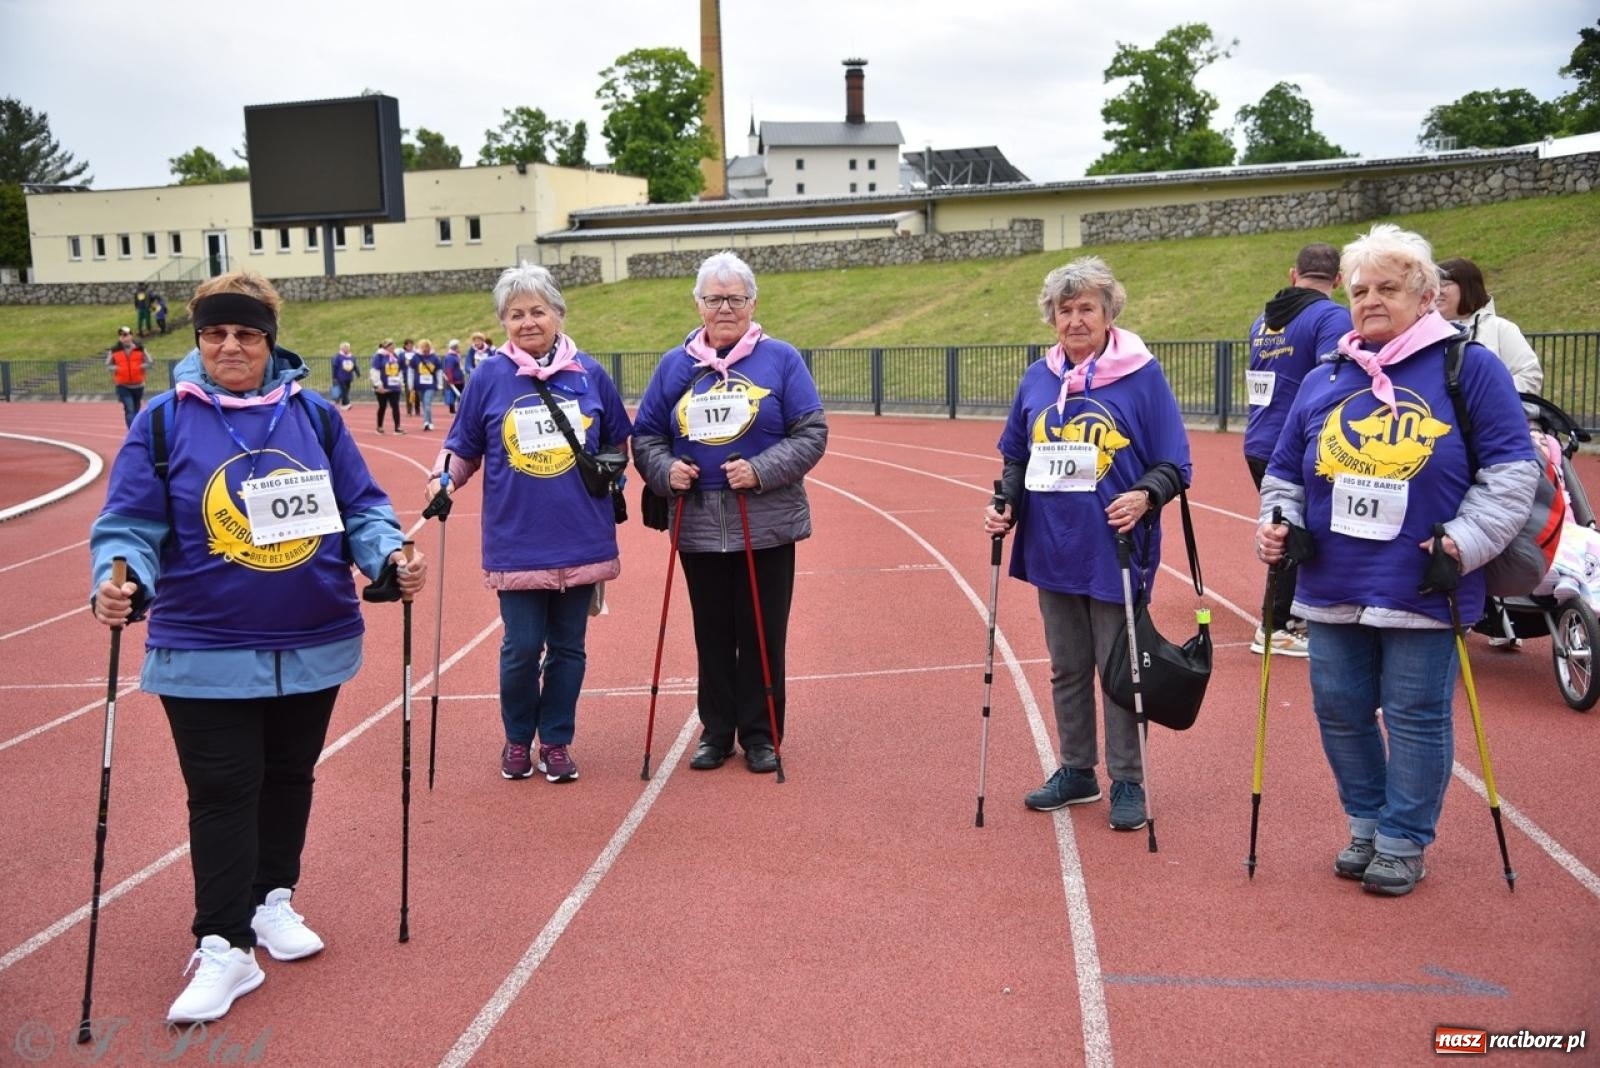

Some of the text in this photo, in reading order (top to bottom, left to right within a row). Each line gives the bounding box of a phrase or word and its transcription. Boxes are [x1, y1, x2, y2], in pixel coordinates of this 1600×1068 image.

[1254, 383, 1268, 394] 017
[704, 407, 731, 423] 117
[534, 419, 562, 435] 13
[1379, 411, 1421, 445] 10
[1075, 421, 1107, 452] 10
[1326, 435, 1377, 477] RACIBORSKI
[1049, 460, 1076, 476] 110
[260, 479, 282, 490] BIEG
[284, 477, 299, 486] BEZ
[1356, 479, 1371, 488] BEZ
[271, 493, 320, 520] 025
[1347, 495, 1380, 519] 161
[249, 551, 268, 564] BIEG
[269, 554, 284, 564] BEZ
